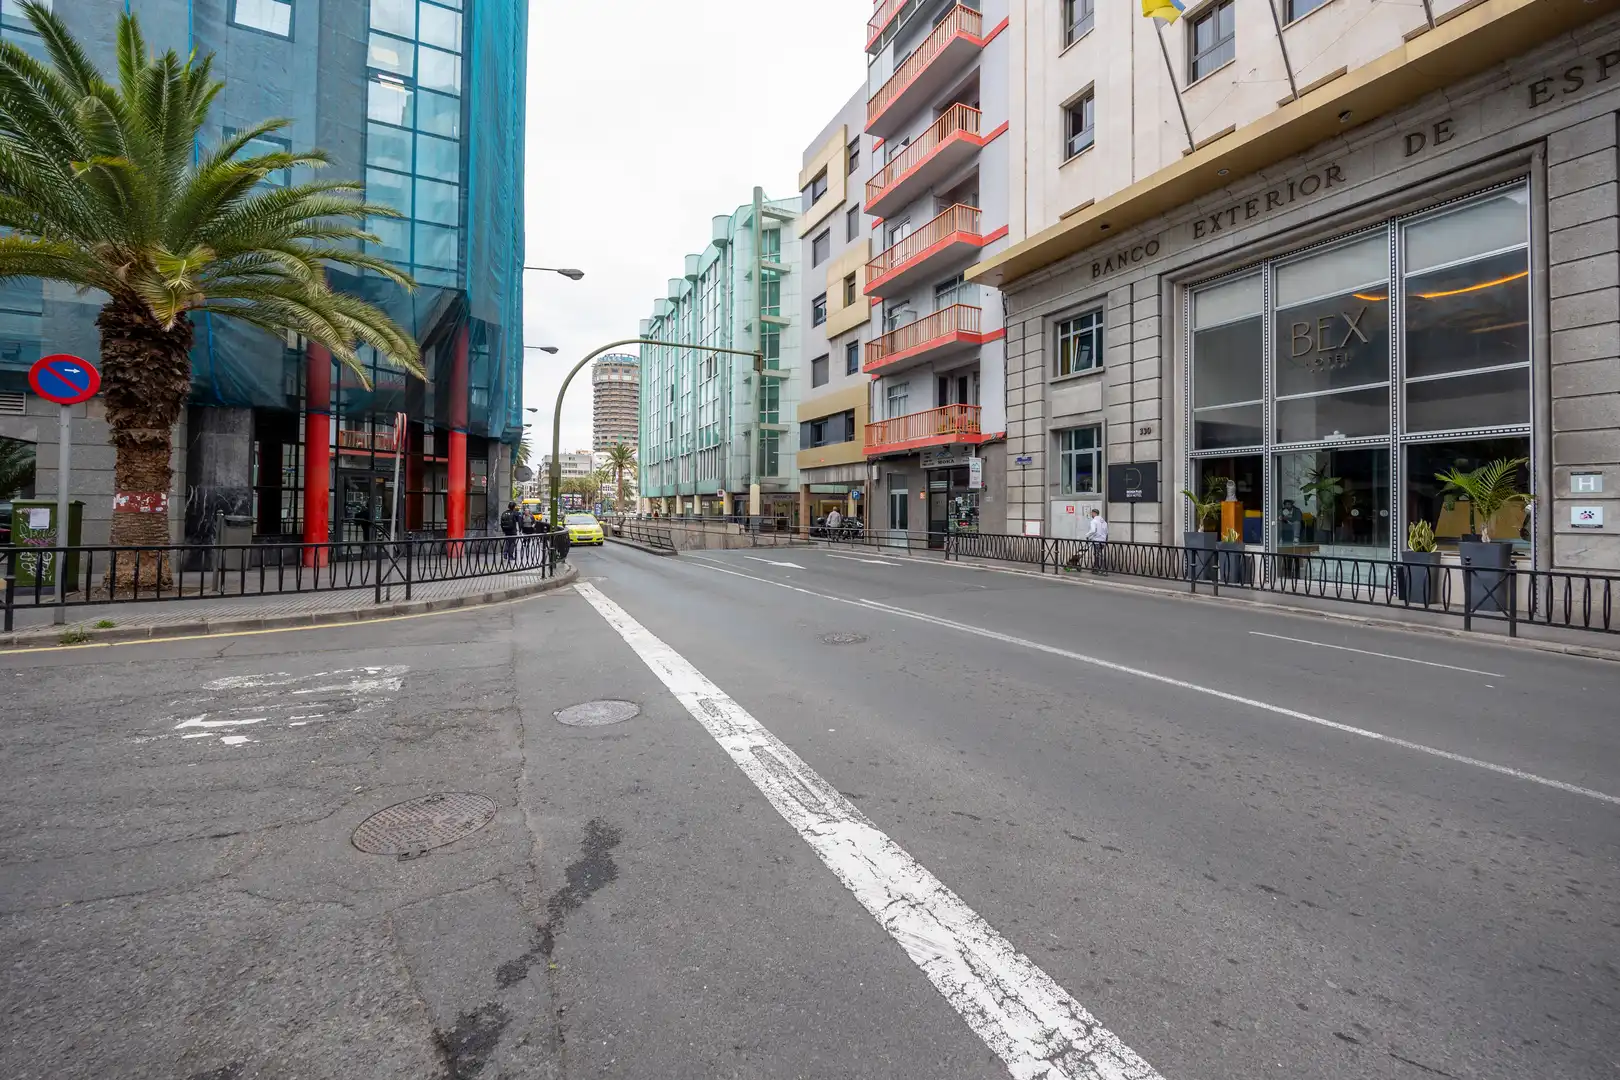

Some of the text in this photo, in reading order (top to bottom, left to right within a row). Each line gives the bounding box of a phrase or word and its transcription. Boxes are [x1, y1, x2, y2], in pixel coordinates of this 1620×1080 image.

[1092, 49, 1620, 279] BANCO EXTERIOR DE ESP
[1291, 305, 1369, 358] BEX
[1139, 427, 1152, 436] 330
[1578, 476, 1595, 491] H
